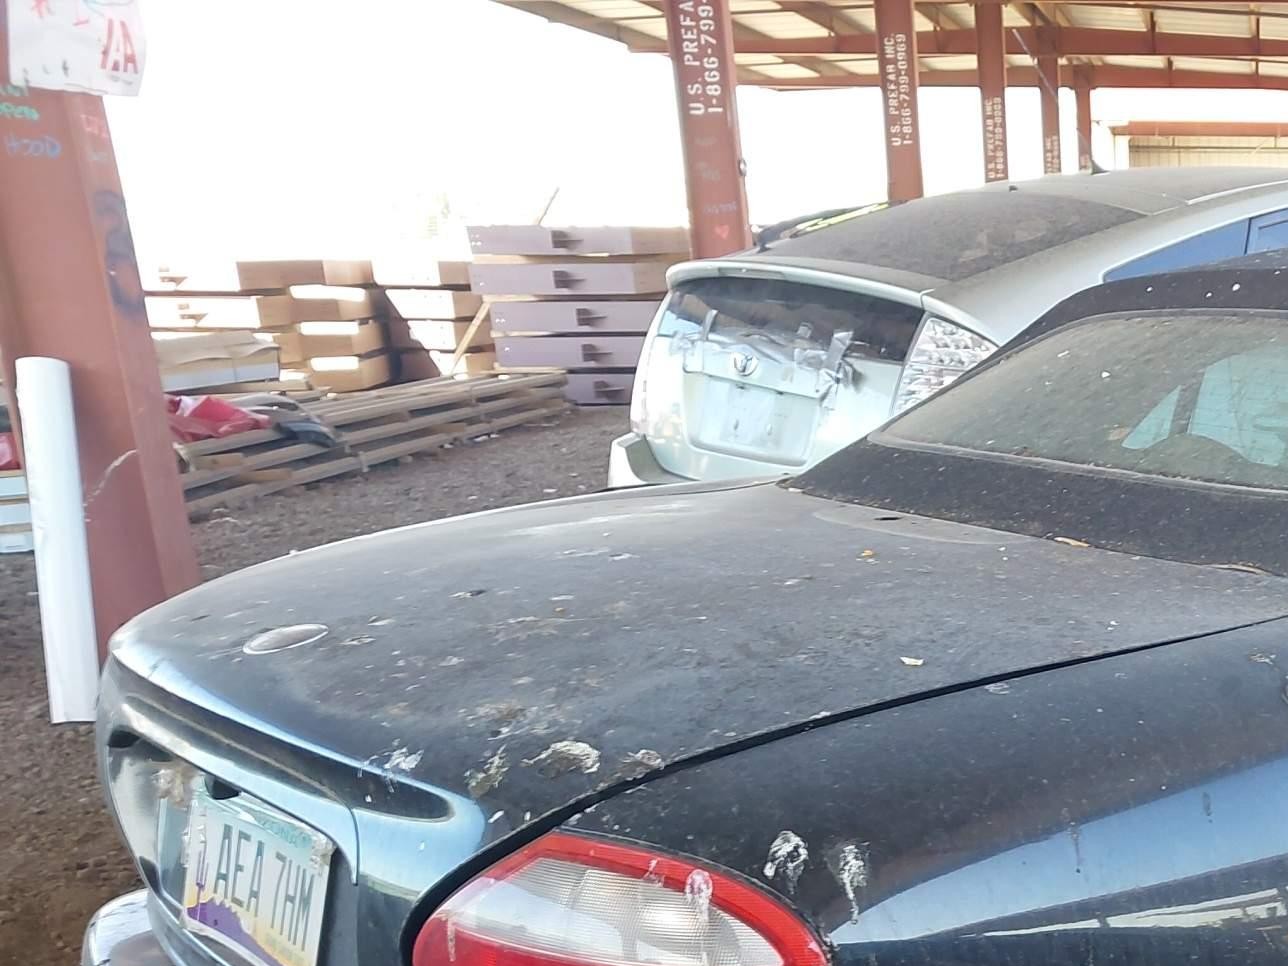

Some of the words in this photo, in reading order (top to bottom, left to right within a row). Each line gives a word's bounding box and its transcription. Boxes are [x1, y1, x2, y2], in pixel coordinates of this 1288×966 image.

[688, 77, 705, 116] U.S.
[889, 121, 902, 147] U.S.
[213, 823, 264, 917] AEA
[270, 851, 316, 951] 7HM
